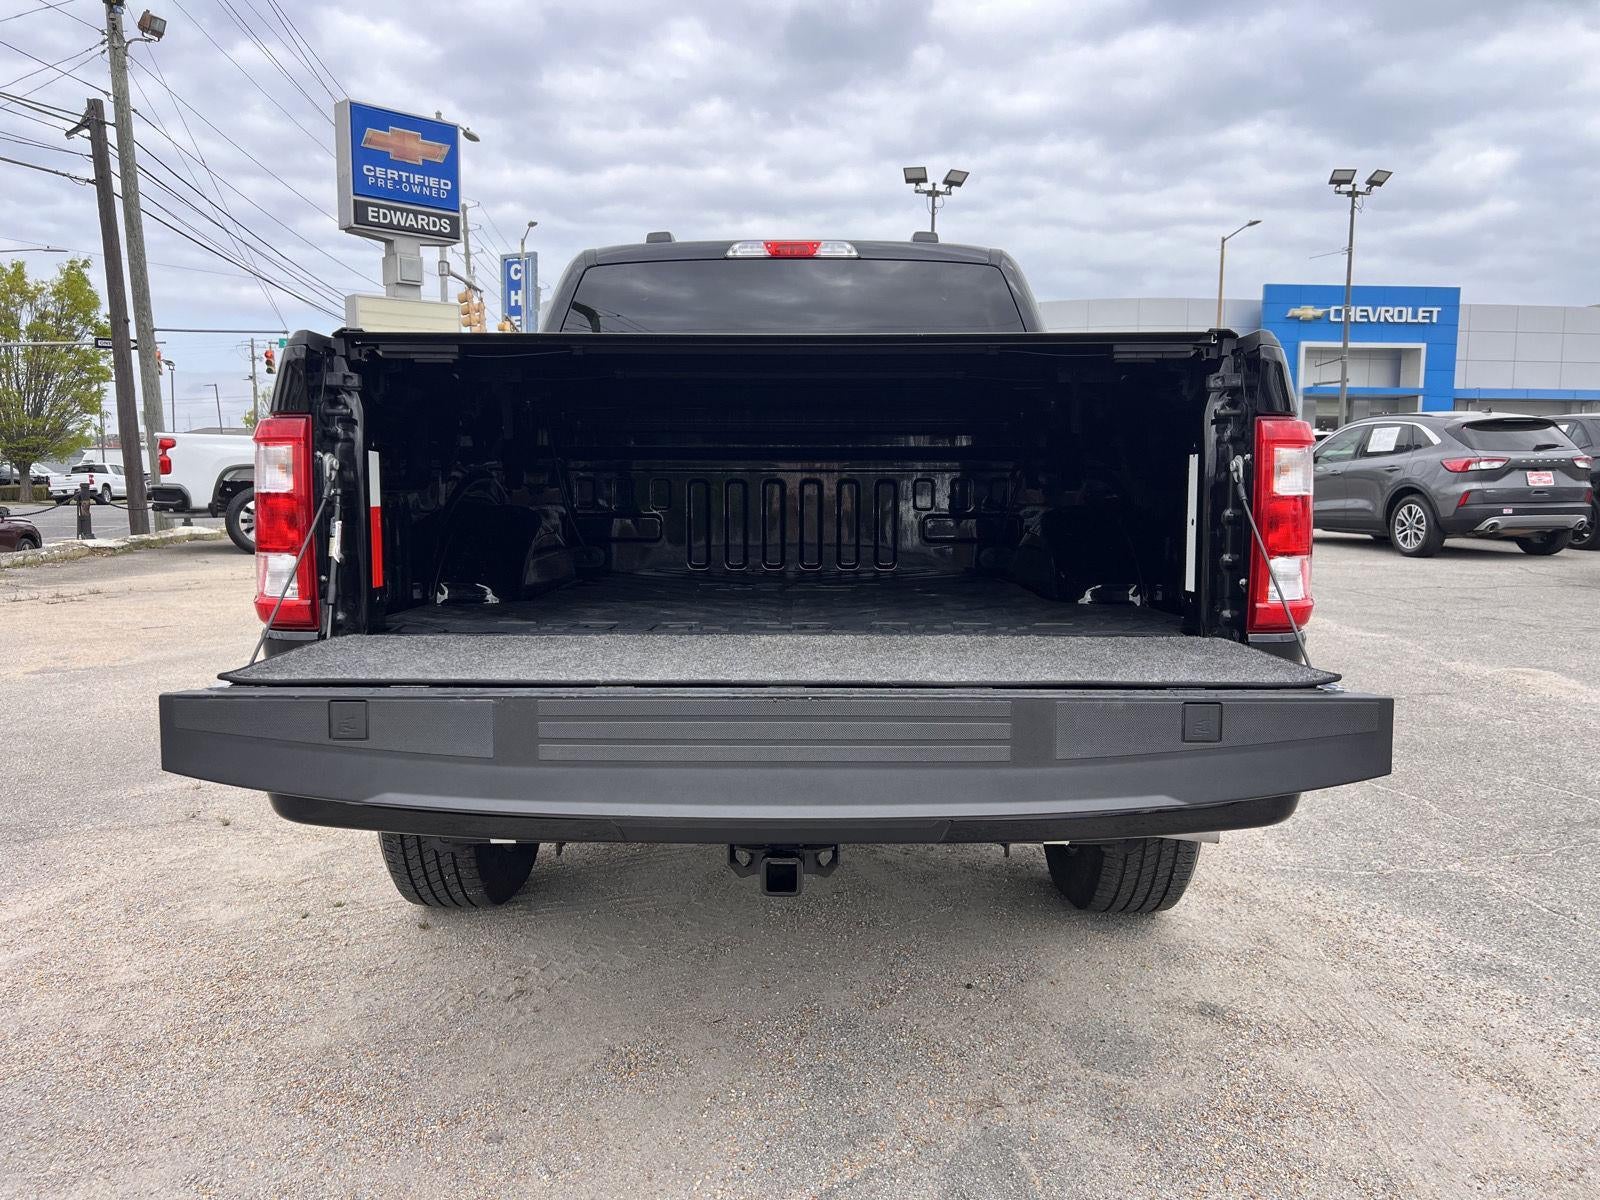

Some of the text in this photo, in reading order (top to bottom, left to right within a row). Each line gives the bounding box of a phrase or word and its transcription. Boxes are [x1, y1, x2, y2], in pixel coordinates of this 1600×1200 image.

[363, 165, 452, 190] CERTIFIED
[368, 177, 447, 199] PRE-OWNED
[368, 207, 450, 233] EDWARDS
[1330, 306, 1441, 323] CHEVROLET
